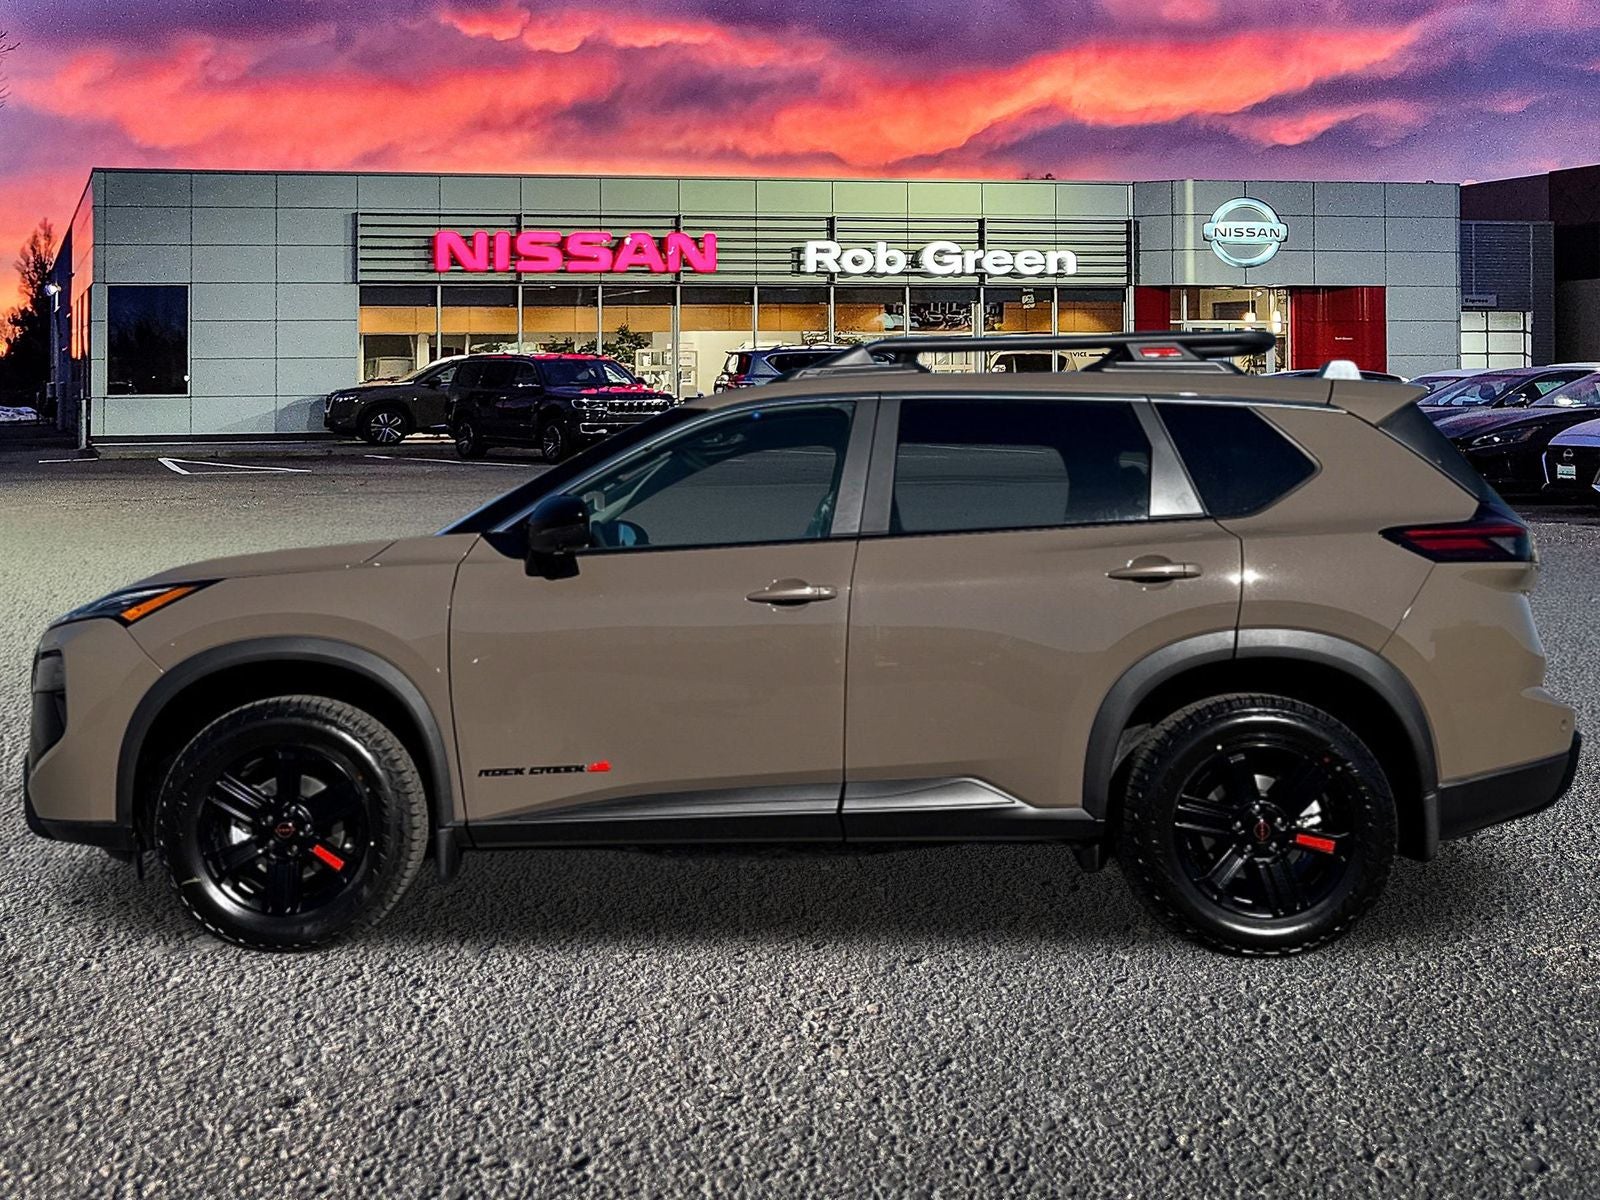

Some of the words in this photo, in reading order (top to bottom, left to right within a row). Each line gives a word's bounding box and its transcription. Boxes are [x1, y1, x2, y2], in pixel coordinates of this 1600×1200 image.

[1214, 227, 1280, 238] NISSAN
[433, 230, 718, 273] NISSAN
[804, 240, 907, 275] Rob
[921, 240, 1078, 276] Green
[478, 767, 526, 777] ROCK
[528, 764, 586, 775] CREEK
